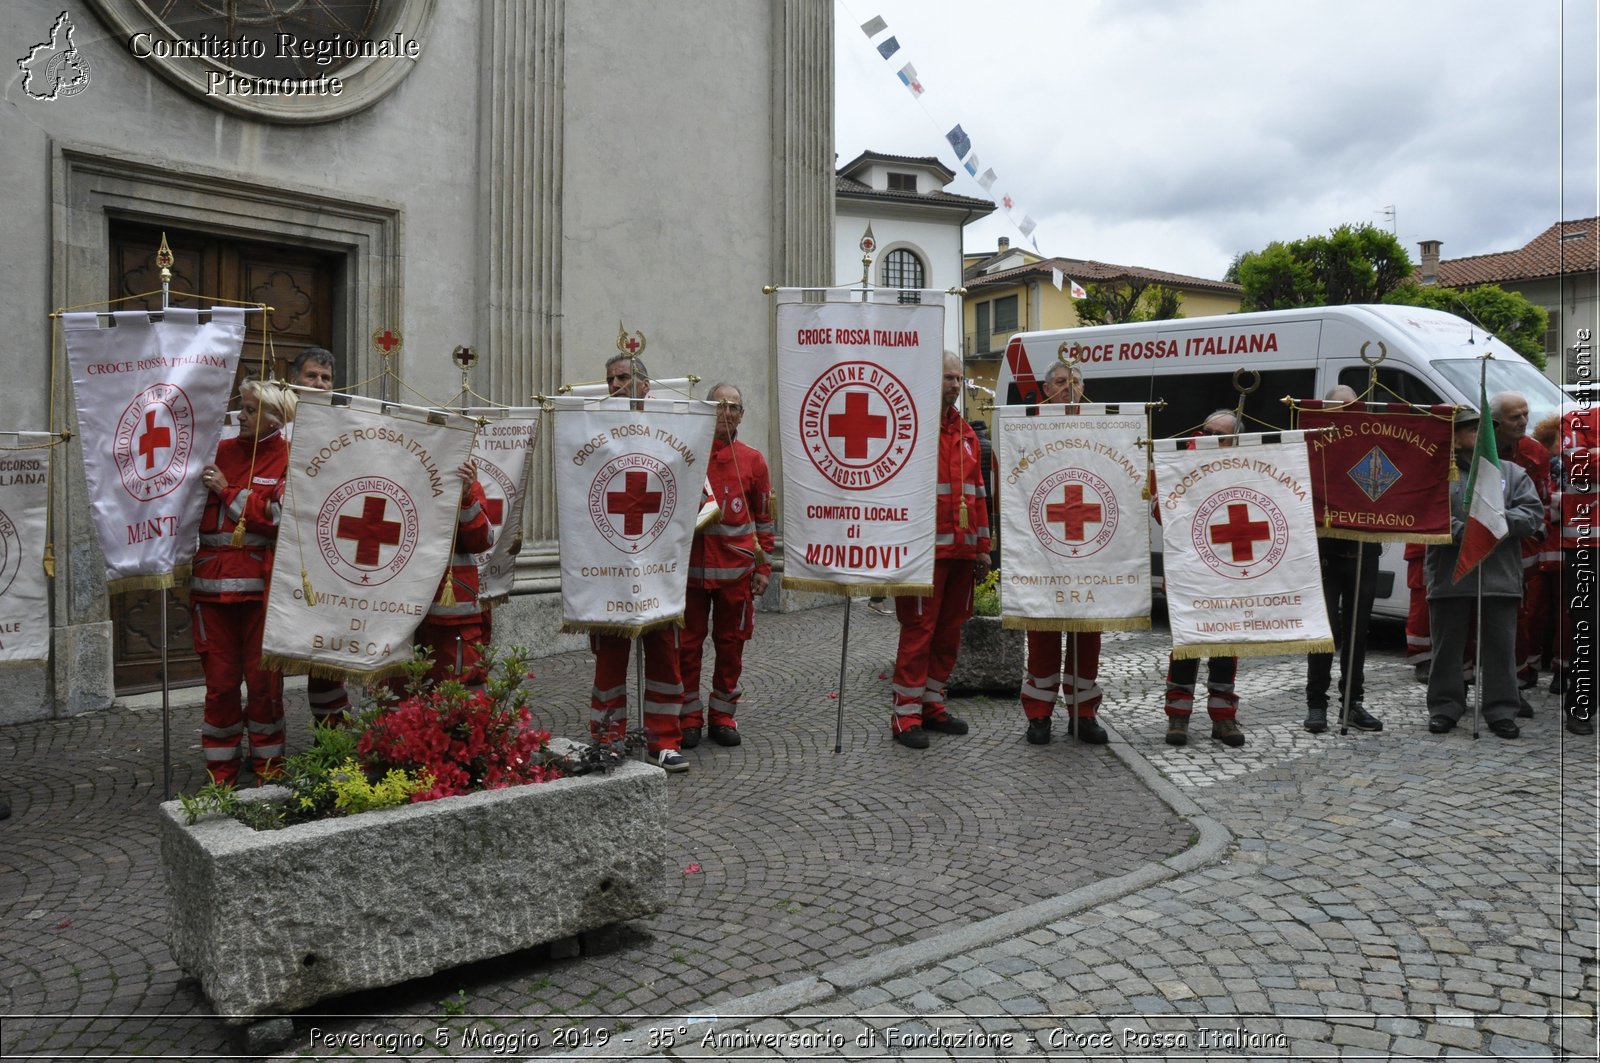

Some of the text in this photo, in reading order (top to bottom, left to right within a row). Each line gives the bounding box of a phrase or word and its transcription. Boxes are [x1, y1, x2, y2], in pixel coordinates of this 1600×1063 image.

[798, 328, 919, 347] CROCE ROSSA ITALIANA
[1119, 339, 1179, 361] ROSSA
[1185, 333, 1279, 357] ITALIANA
[87, 354, 228, 376] CROCE ROSSA ITALIANA
[131, 402, 142, 420] DI
[805, 366, 912, 440] CONVENZIONE DI GINEVRA
[174, 406, 188, 421] 22
[475, 425, 532, 437] EL SOCCORSO
[1004, 422, 1141, 432] CORPO VOLONTARI DEL SOCCORSO
[172, 423, 189, 473] AGOSTO
[573, 424, 696, 467] CROCE ROSSA ITALIANA
[1360, 422, 1438, 457] COMUNALE
[0, 460, 40, 471] CCORSO
[305, 428, 444, 498] CROCE ROSSA ITALIANA
[818, 454, 897, 486] 22 AGOSTO 1864
[1045, 438, 1091, 455] ROSSA
[1093, 441, 1142, 485] ITALIANA
[0, 473, 46, 486] LIANA
[154, 471, 178, 492] 1864
[484, 464, 515, 499] GINEVRA
[1165, 457, 1306, 511] CROCE ROSSA ITALIANA
[591, 456, 675, 539] CONVENZIONE DI GINEVRA 22 AGOSTO 1864
[807, 505, 909, 521] COMITATO LOCALE
[1031, 470, 1116, 546] CONVENZIONE DI GINEVRA 22 AGOSTO 1864
[319, 480, 417, 572] CONVENZIONE DI GINEVRA 22 AGOSTO 1864
[1330, 510, 1415, 527] PEVERAGNO
[847, 525, 860, 538] di
[1194, 490, 1286, 568] CONVENZIONE DI GINEVRA 22 AGOSTO 1864
[805, 543, 908, 569] MONDOVI'
[490, 565, 501, 576] DI
[582, 562, 678, 578] COMITATO LOCALE
[1011, 574, 1140, 585] COMITATO LOCALE DI
[632, 584, 642, 594] DI
[1055, 590, 1096, 603] BRA
[293, 589, 423, 616] CMITATO LOCALE
[607, 597, 660, 613] DRONERO
[1193, 596, 1302, 610] COMITATO LOCALE
[1244, 610, 1254, 618] DI
[351, 618, 366, 632] DI
[1196, 619, 1304, 632] LIMONE PIEMONTE
[312, 635, 391, 656] BUSCA
